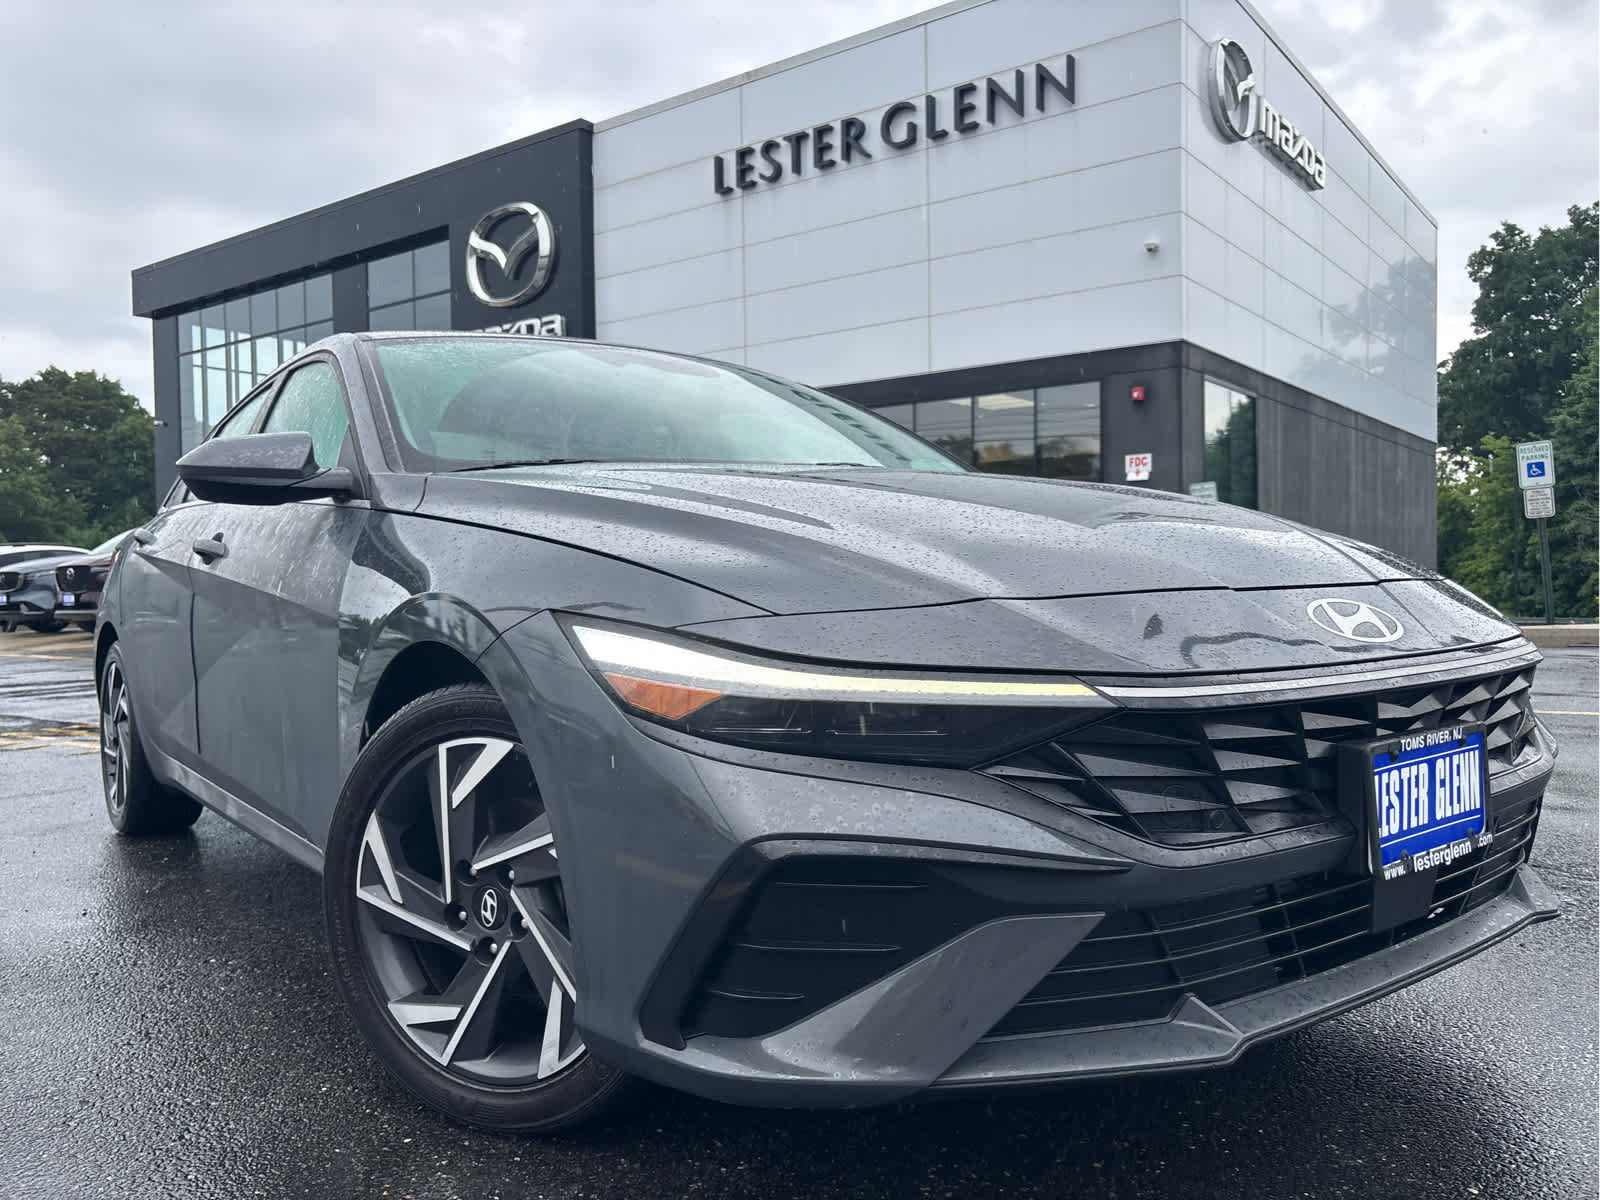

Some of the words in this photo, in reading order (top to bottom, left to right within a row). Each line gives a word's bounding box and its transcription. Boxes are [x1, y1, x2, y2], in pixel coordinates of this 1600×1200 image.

[713, 117, 872, 197] LESTER
[879, 53, 1077, 151] GLENN
[1257, 96, 1326, 190] mazda
[473, 314, 563, 336] zda
[1128, 456, 1148, 467] FDC
[1401, 735, 1425, 752] TOMS
[1453, 727, 1463, 740] NJ
[1435, 750, 1481, 820] GLENN
[1383, 864, 1406, 881] www.
[1413, 840, 1472, 873] lesterglenn
